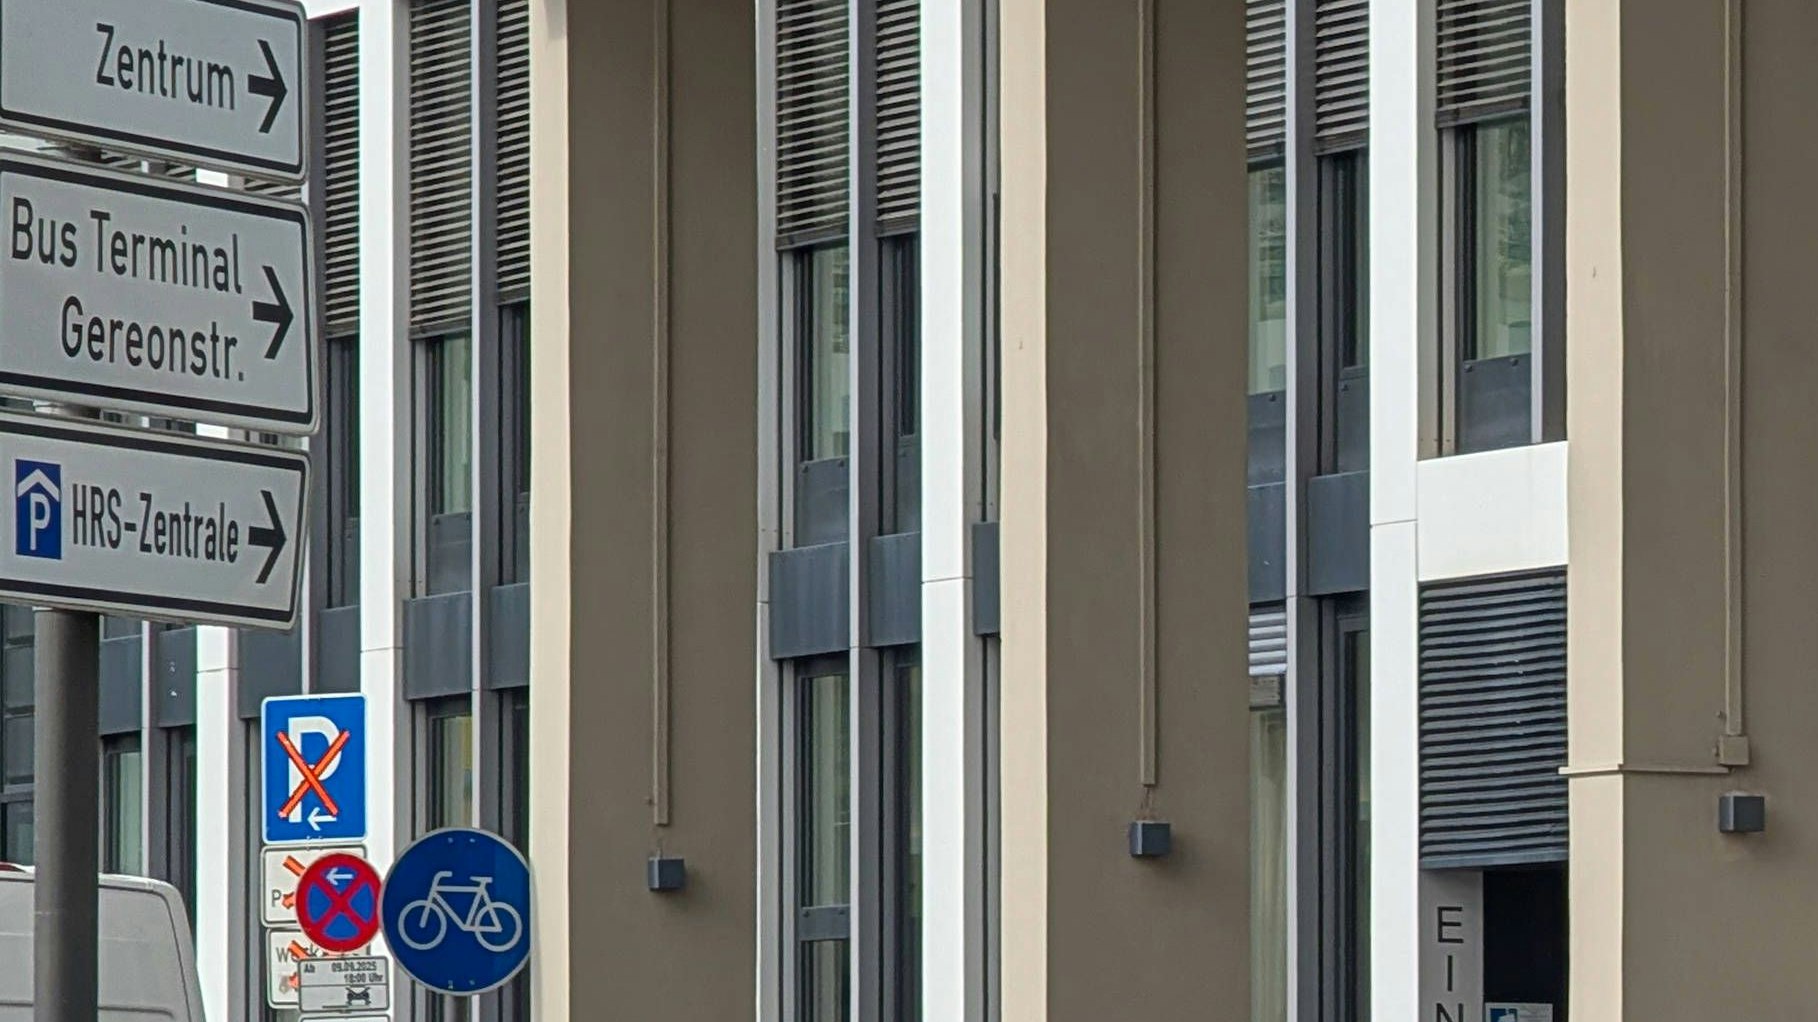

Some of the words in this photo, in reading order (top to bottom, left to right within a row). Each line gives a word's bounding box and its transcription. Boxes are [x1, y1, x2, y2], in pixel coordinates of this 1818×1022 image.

[95, 22, 236, 111] Zentrum
[11, 196, 78, 269] Bus
[91, 209, 243, 294] Terminal
[61, 295, 244, 382] Gereonstr.
[72, 482, 239, 563] HRS-Zentrale
